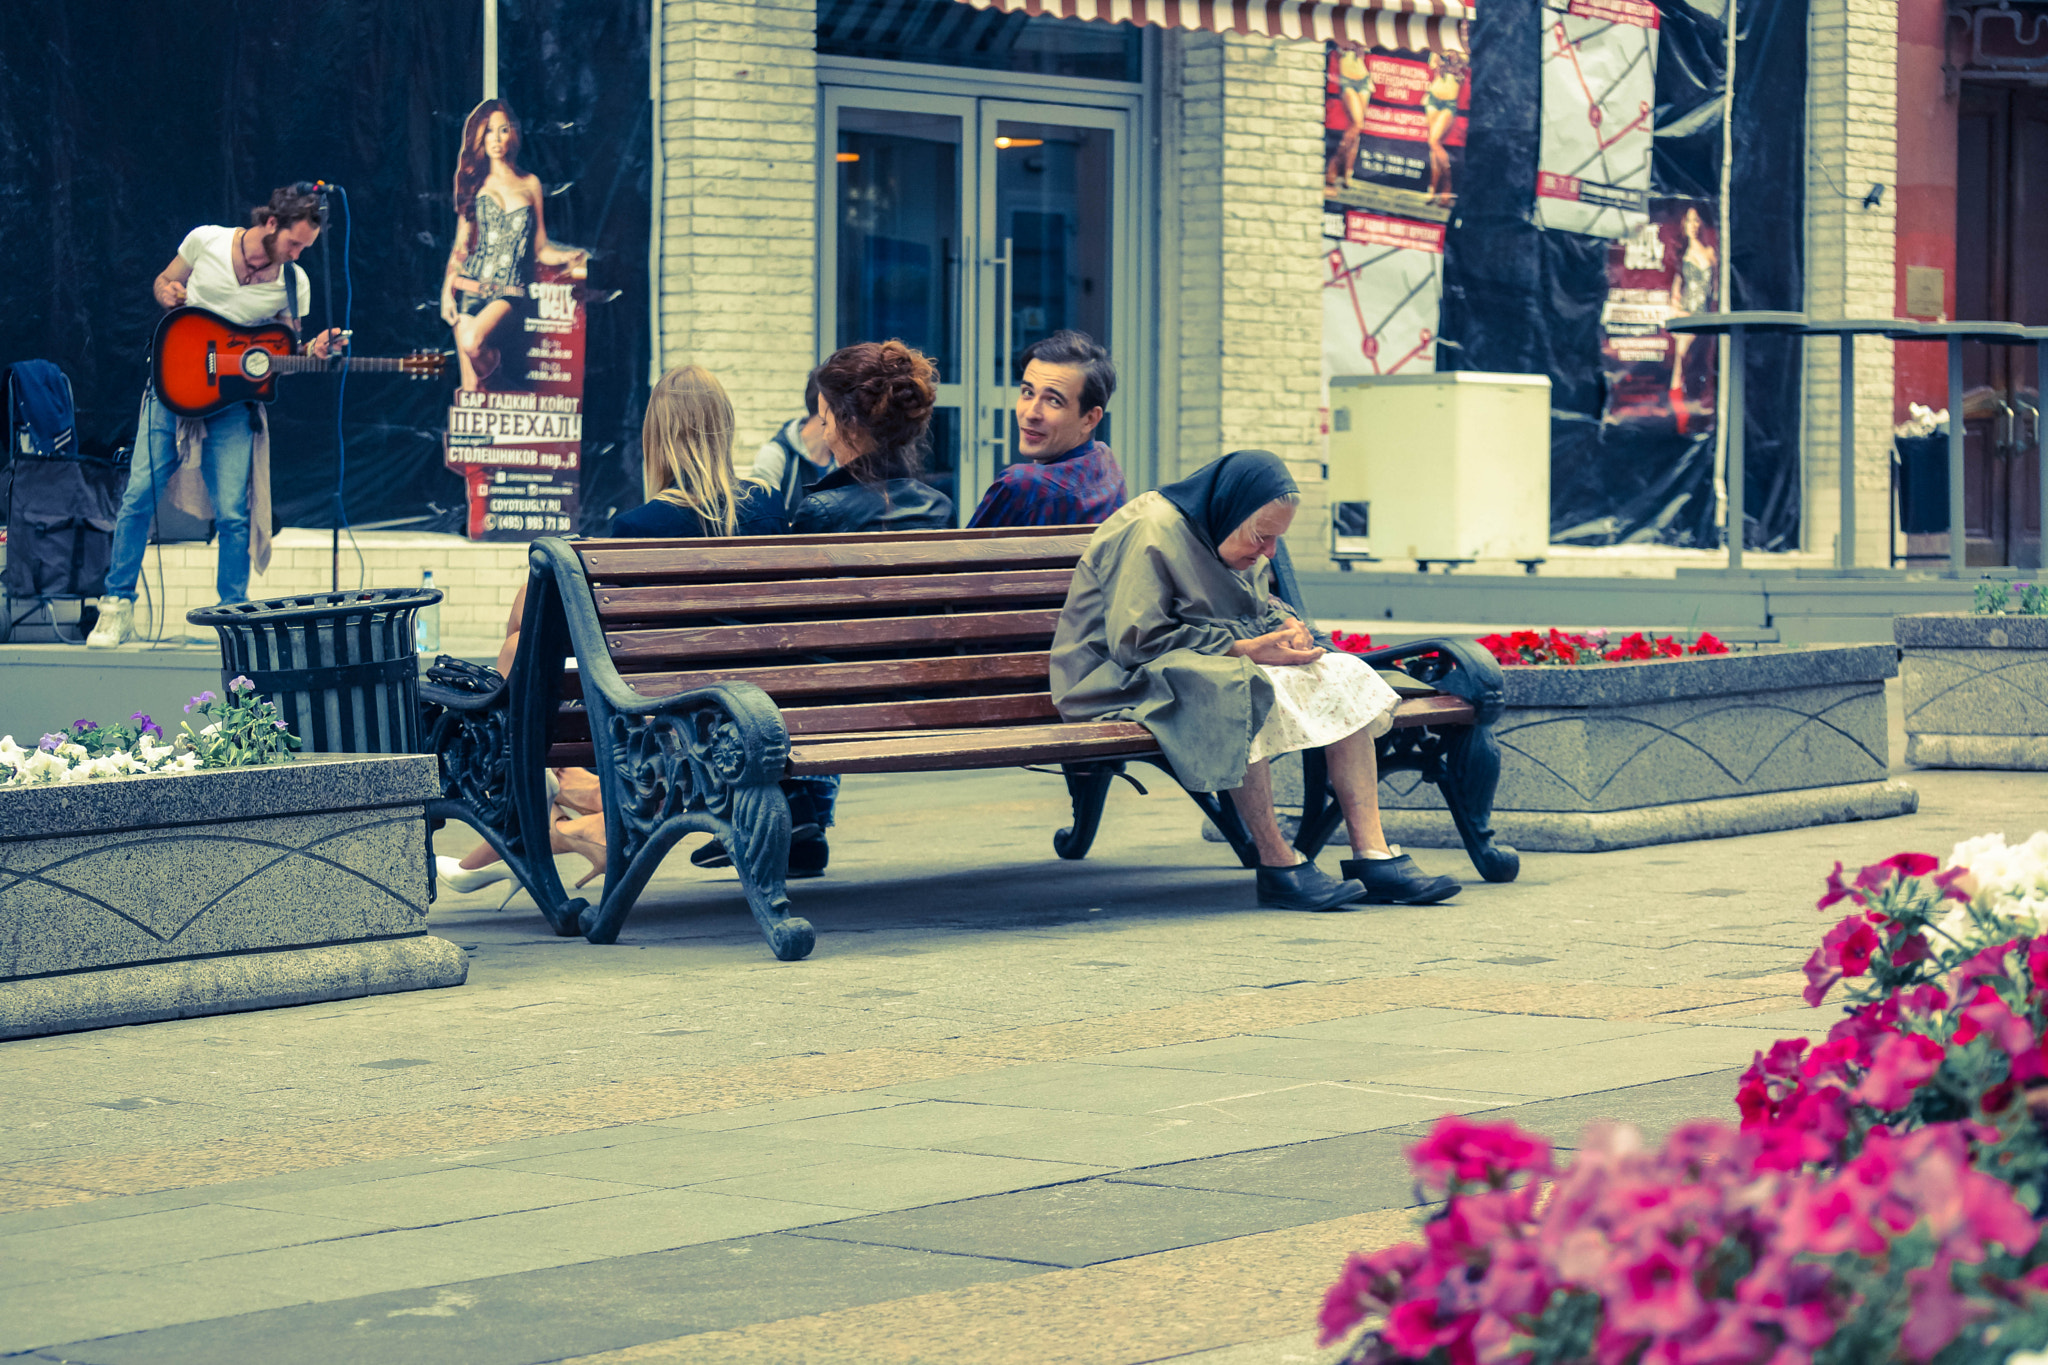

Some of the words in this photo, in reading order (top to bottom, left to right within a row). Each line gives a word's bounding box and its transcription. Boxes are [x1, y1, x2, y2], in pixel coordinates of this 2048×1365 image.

[528, 282, 575, 299] COYOTE
[538, 299, 577, 320] UGLY
[461, 391, 486, 408] БАР
[487, 391, 537, 411] ГАДКИЙ
[538, 394, 580, 414] КОЙОТ
[453, 411, 579, 439] ПЕРЕЕХАЛ!
[448, 446, 538, 466] СТОЛЕШНИКОВ
[490, 498, 561, 513] COYOTEUGLY.RU
